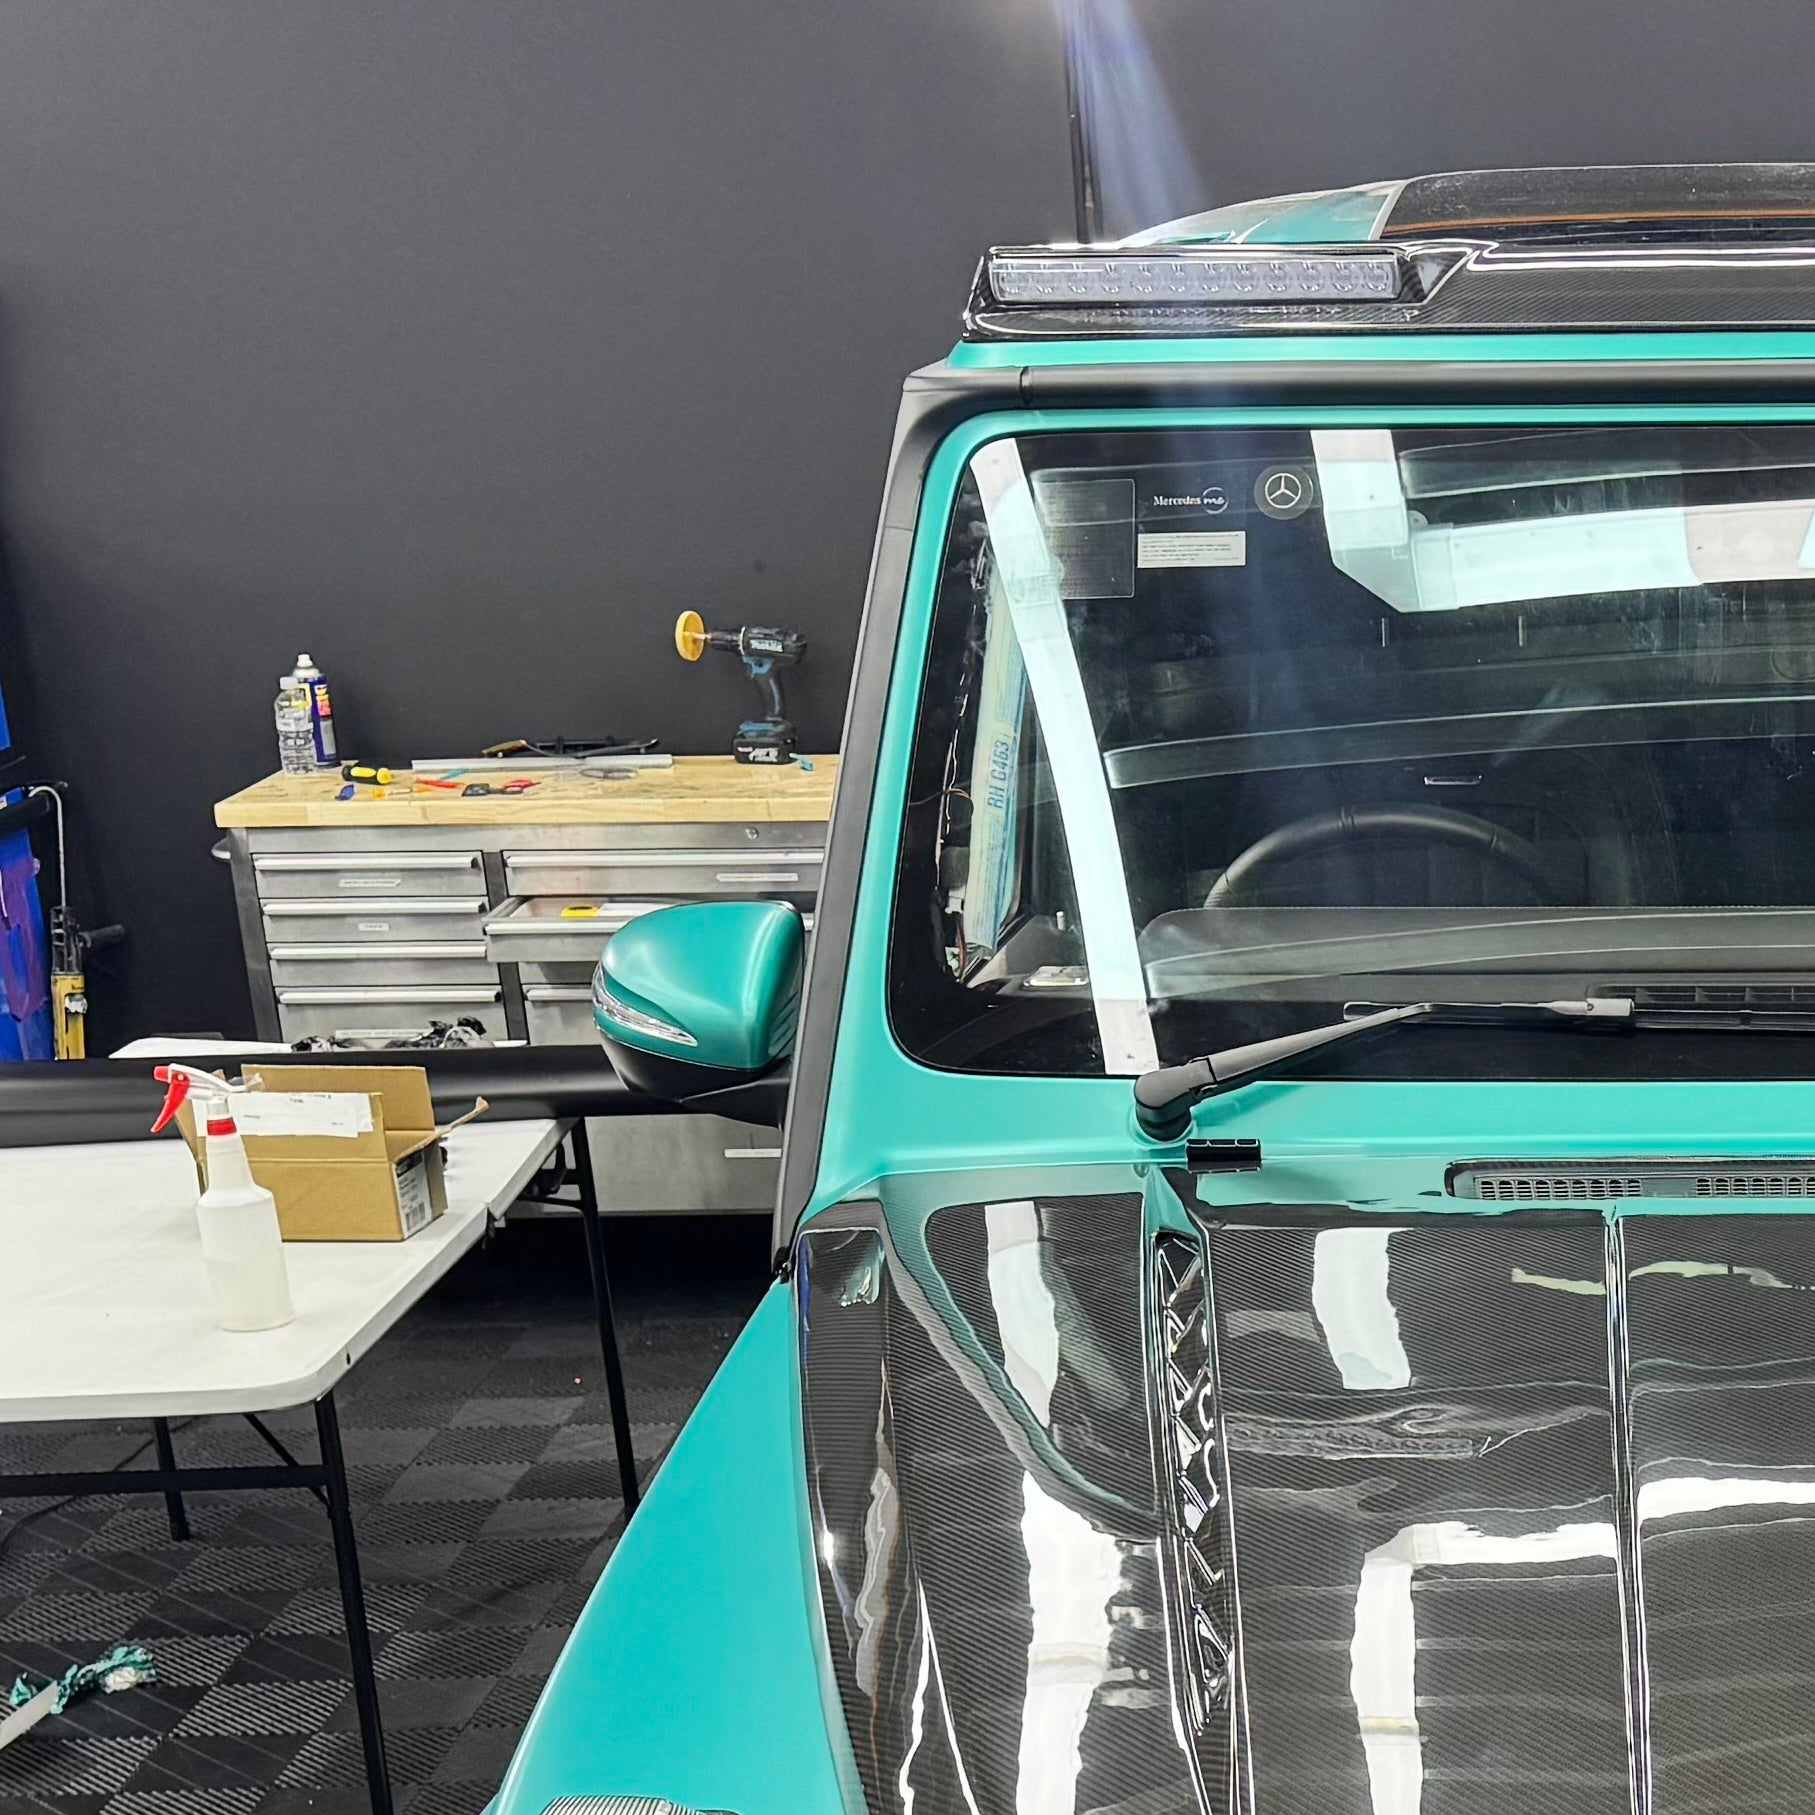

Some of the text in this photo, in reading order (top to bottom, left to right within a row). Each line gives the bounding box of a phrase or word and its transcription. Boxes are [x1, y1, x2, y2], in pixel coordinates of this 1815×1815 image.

[1153, 495, 1201, 506] Mercedes
[987, 740, 1009, 809] RH G463
